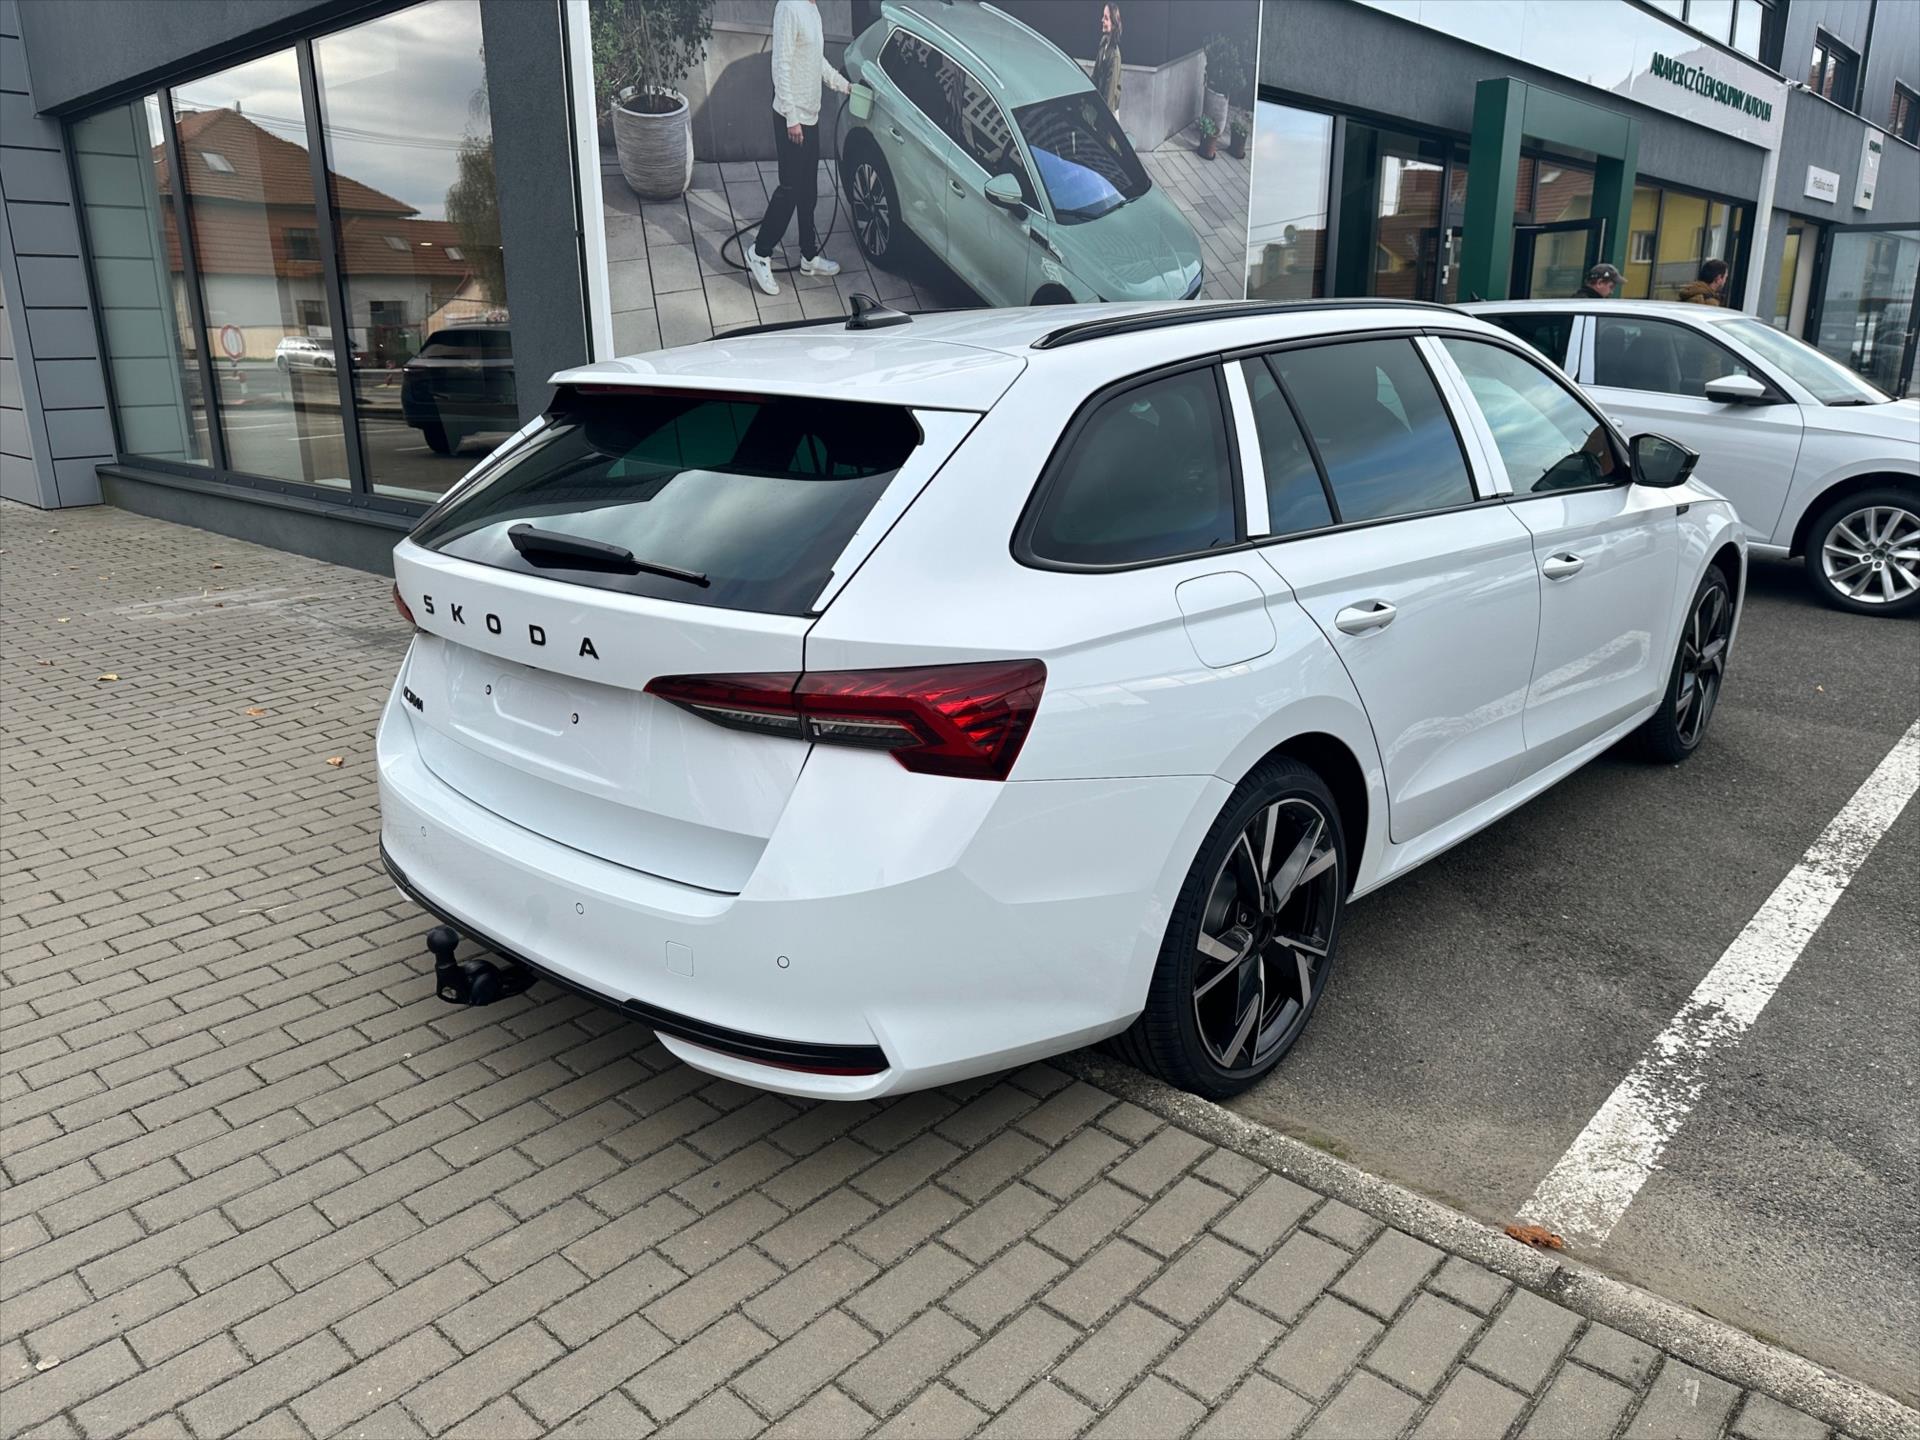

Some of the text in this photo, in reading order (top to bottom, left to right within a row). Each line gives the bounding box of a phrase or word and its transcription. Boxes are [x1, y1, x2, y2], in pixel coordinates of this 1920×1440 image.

[1650, 51, 1685, 86] ARAVER
[1684, 67, 1697, 90] CZ
[1696, 66, 1716, 99] ČLEN
[1714, 80, 1746, 110] SKUPINY
